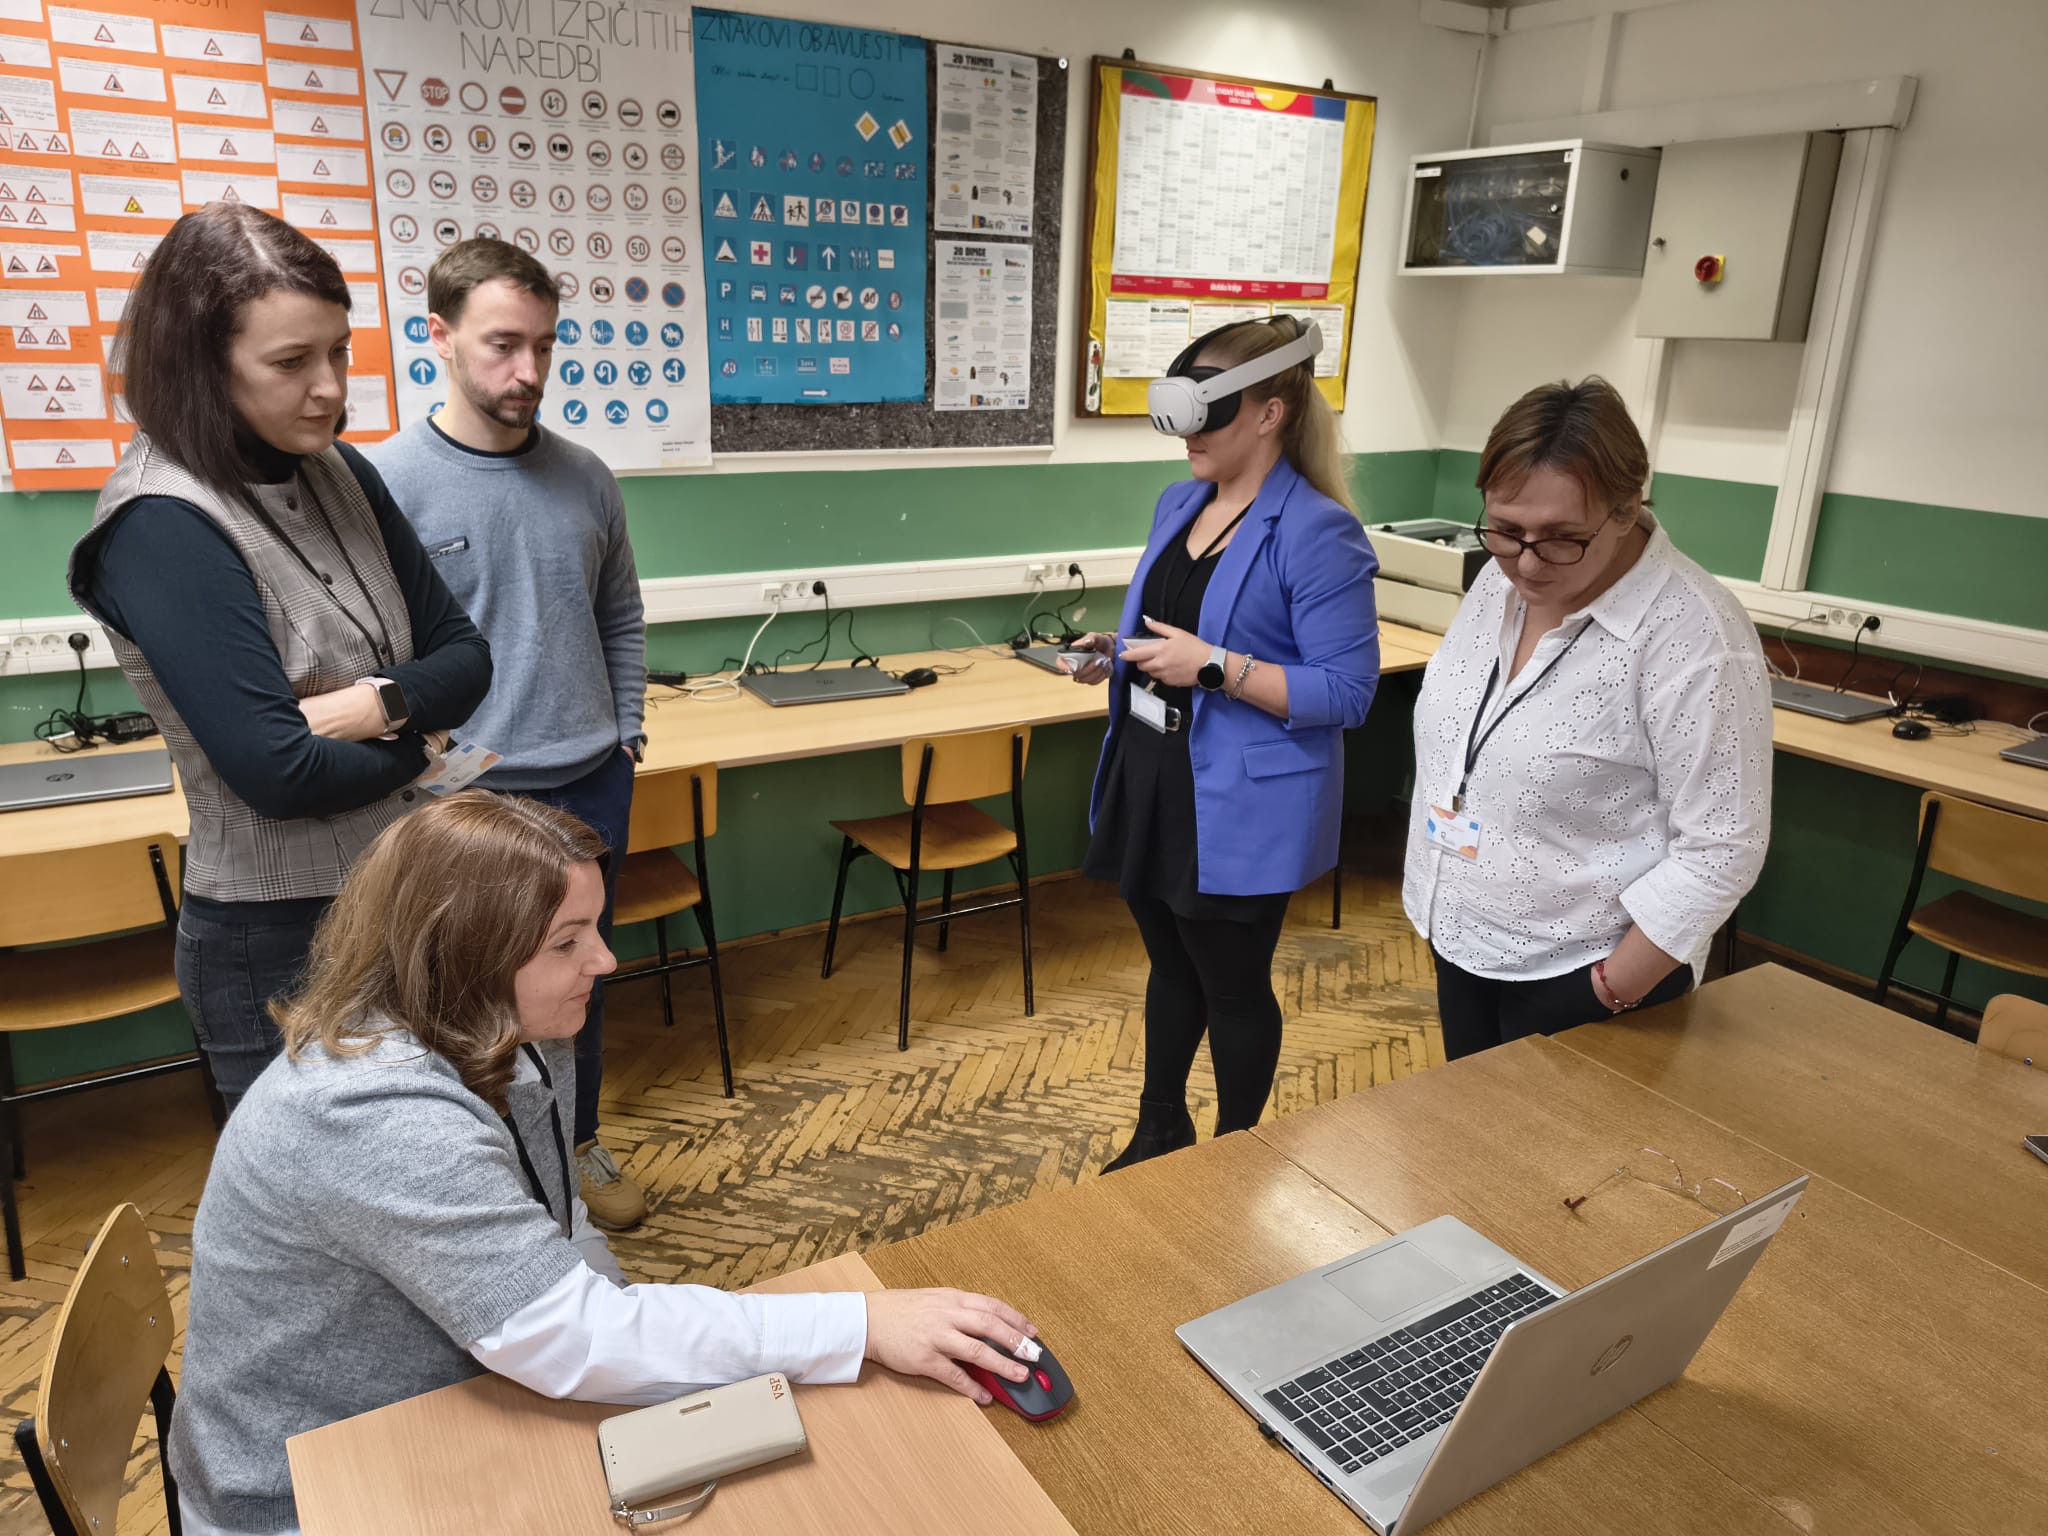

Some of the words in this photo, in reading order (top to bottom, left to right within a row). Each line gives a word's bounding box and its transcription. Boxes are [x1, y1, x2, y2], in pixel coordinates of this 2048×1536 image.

[551, 0, 692, 53] IZRIČITIH
[700, 15, 792, 48] ZNAKOVI
[799, 25, 903, 62] OBAVIJESTI
[460, 32, 601, 83] NAREDBI
[422, 85, 449, 100] STOP
[631, 242, 646, 255] 50
[721, 282, 731, 298] P
[410, 323, 427, 337] 40
[721, 319, 729, 331] H
